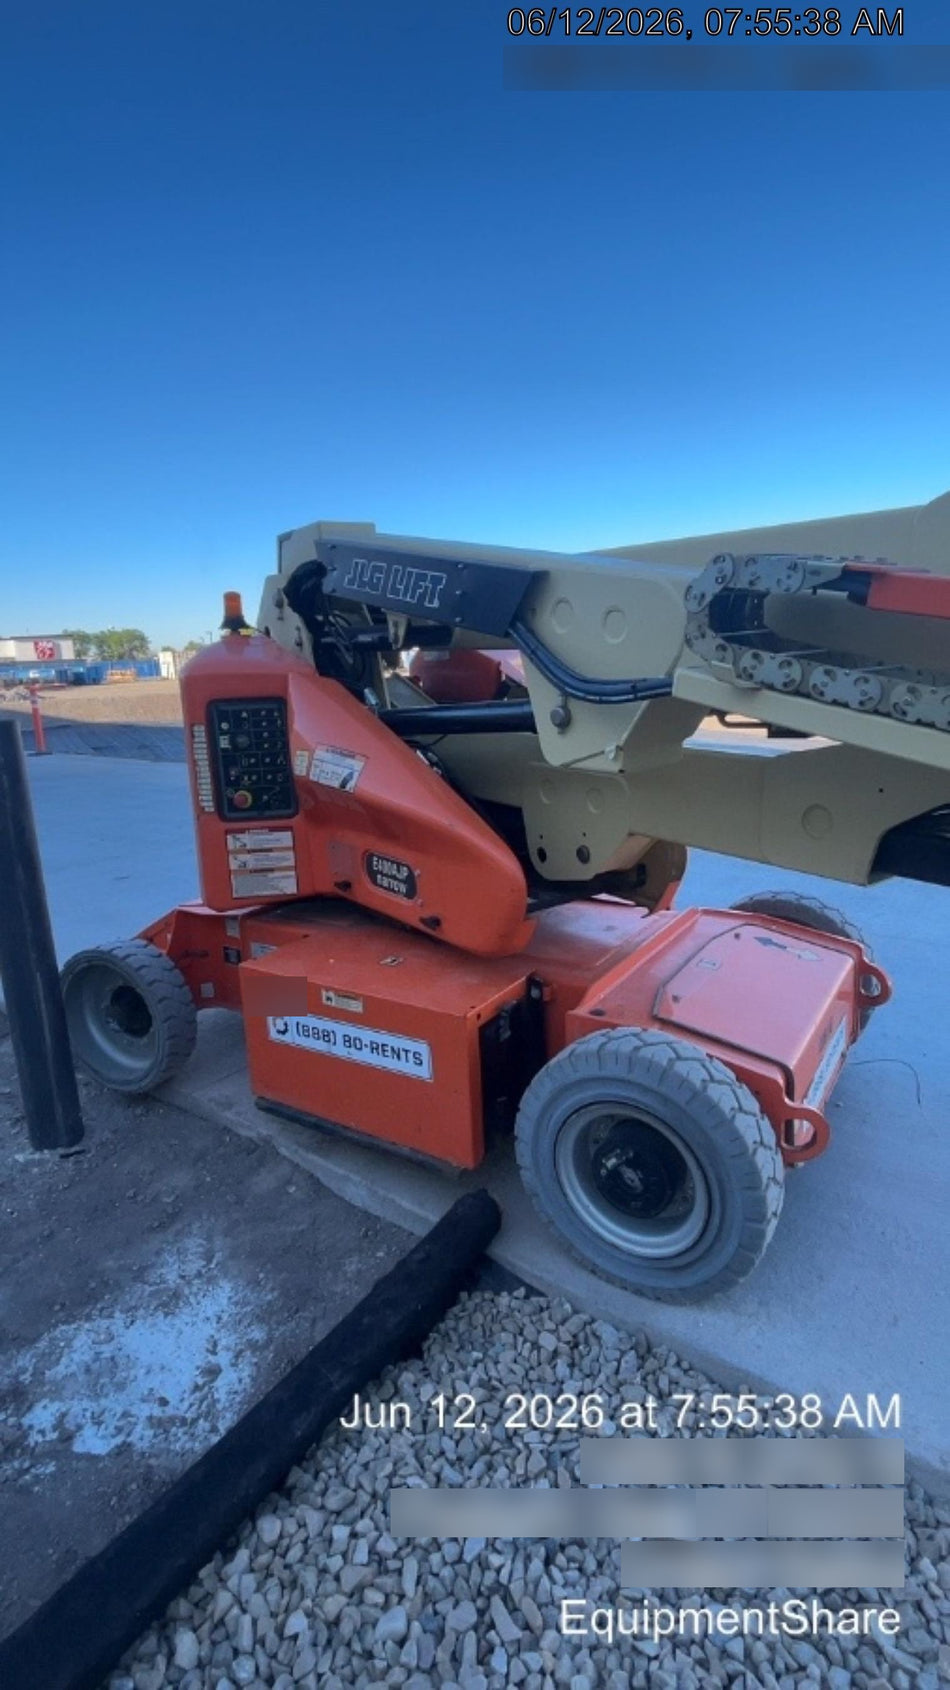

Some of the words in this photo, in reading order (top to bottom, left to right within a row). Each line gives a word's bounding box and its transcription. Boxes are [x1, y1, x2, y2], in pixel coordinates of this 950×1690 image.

[344, 558, 388, 594] JLG
[386, 565, 447, 608] LIFT
[296, 1021, 337, 1046] (888)
